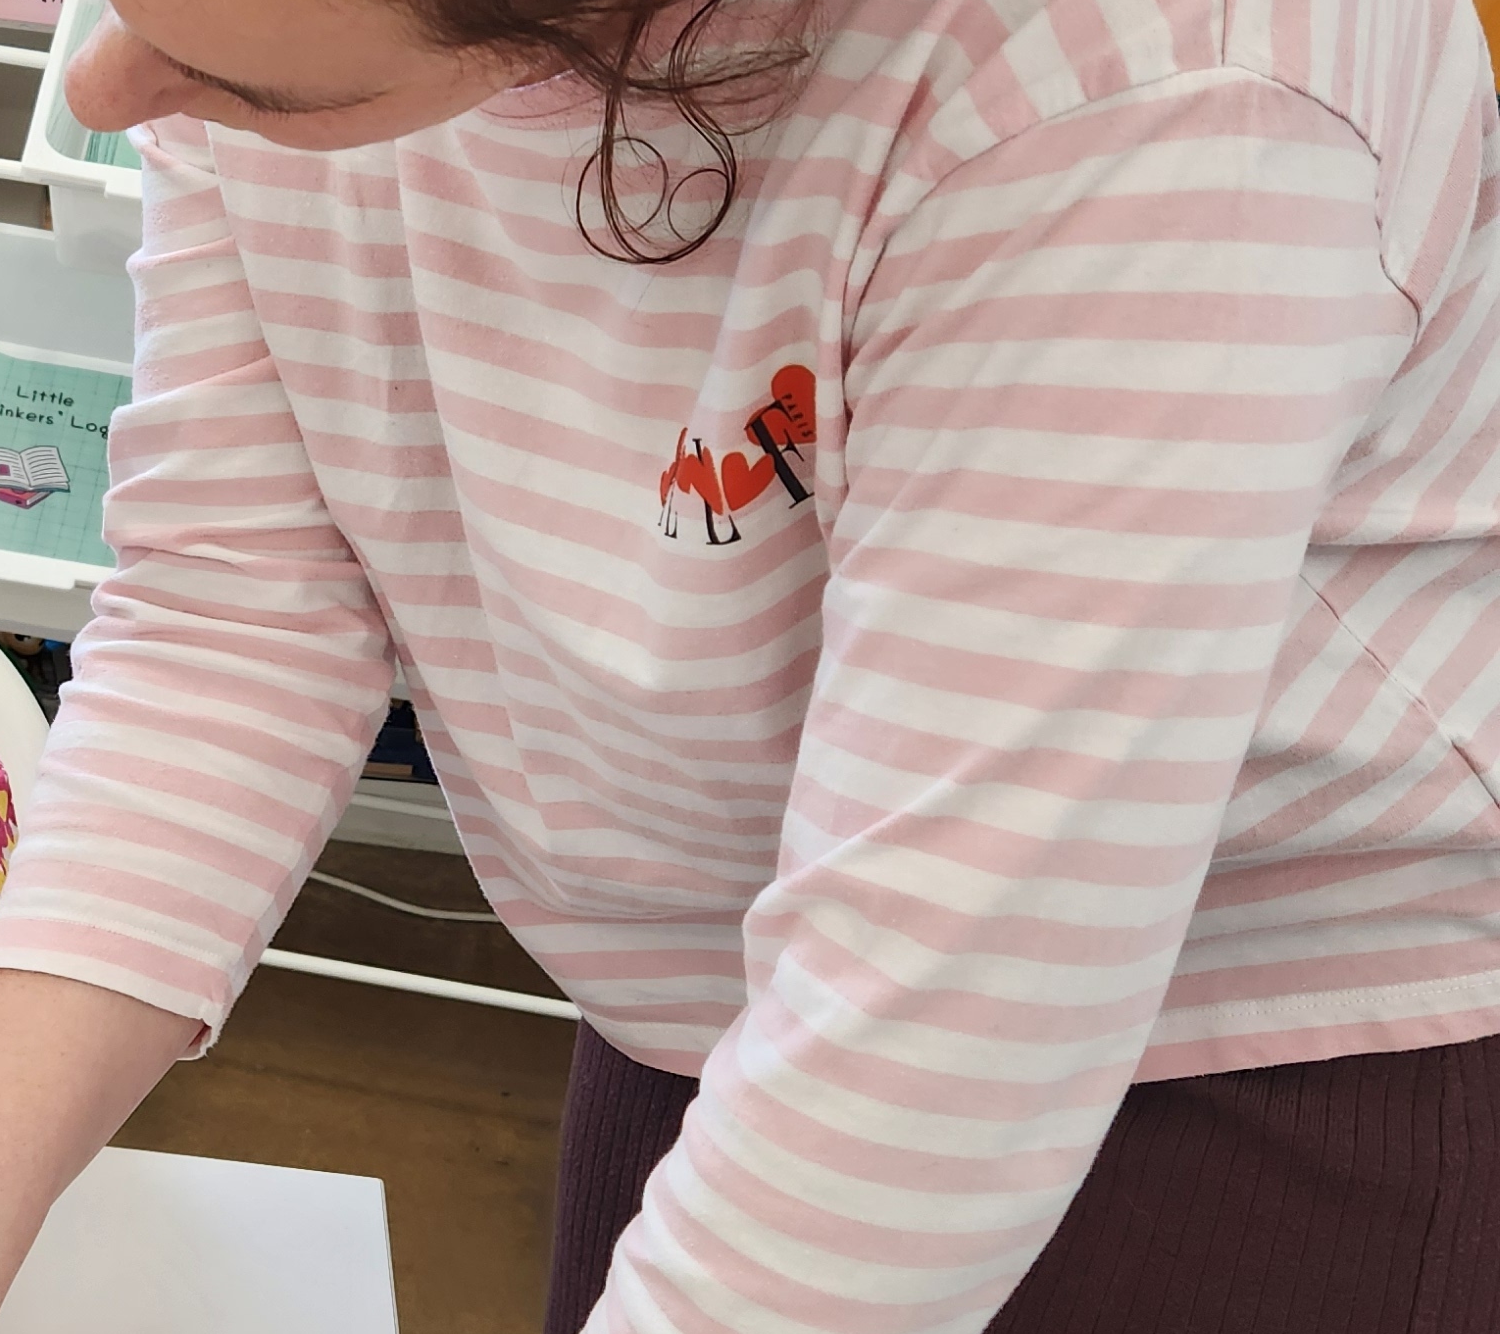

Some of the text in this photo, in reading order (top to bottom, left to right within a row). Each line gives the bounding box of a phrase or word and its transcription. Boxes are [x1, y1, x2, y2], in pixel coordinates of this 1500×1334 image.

[16, 385, 75, 408] Little
[70, 415, 110, 440] Log
[781, 392, 815, 439] PARIS
